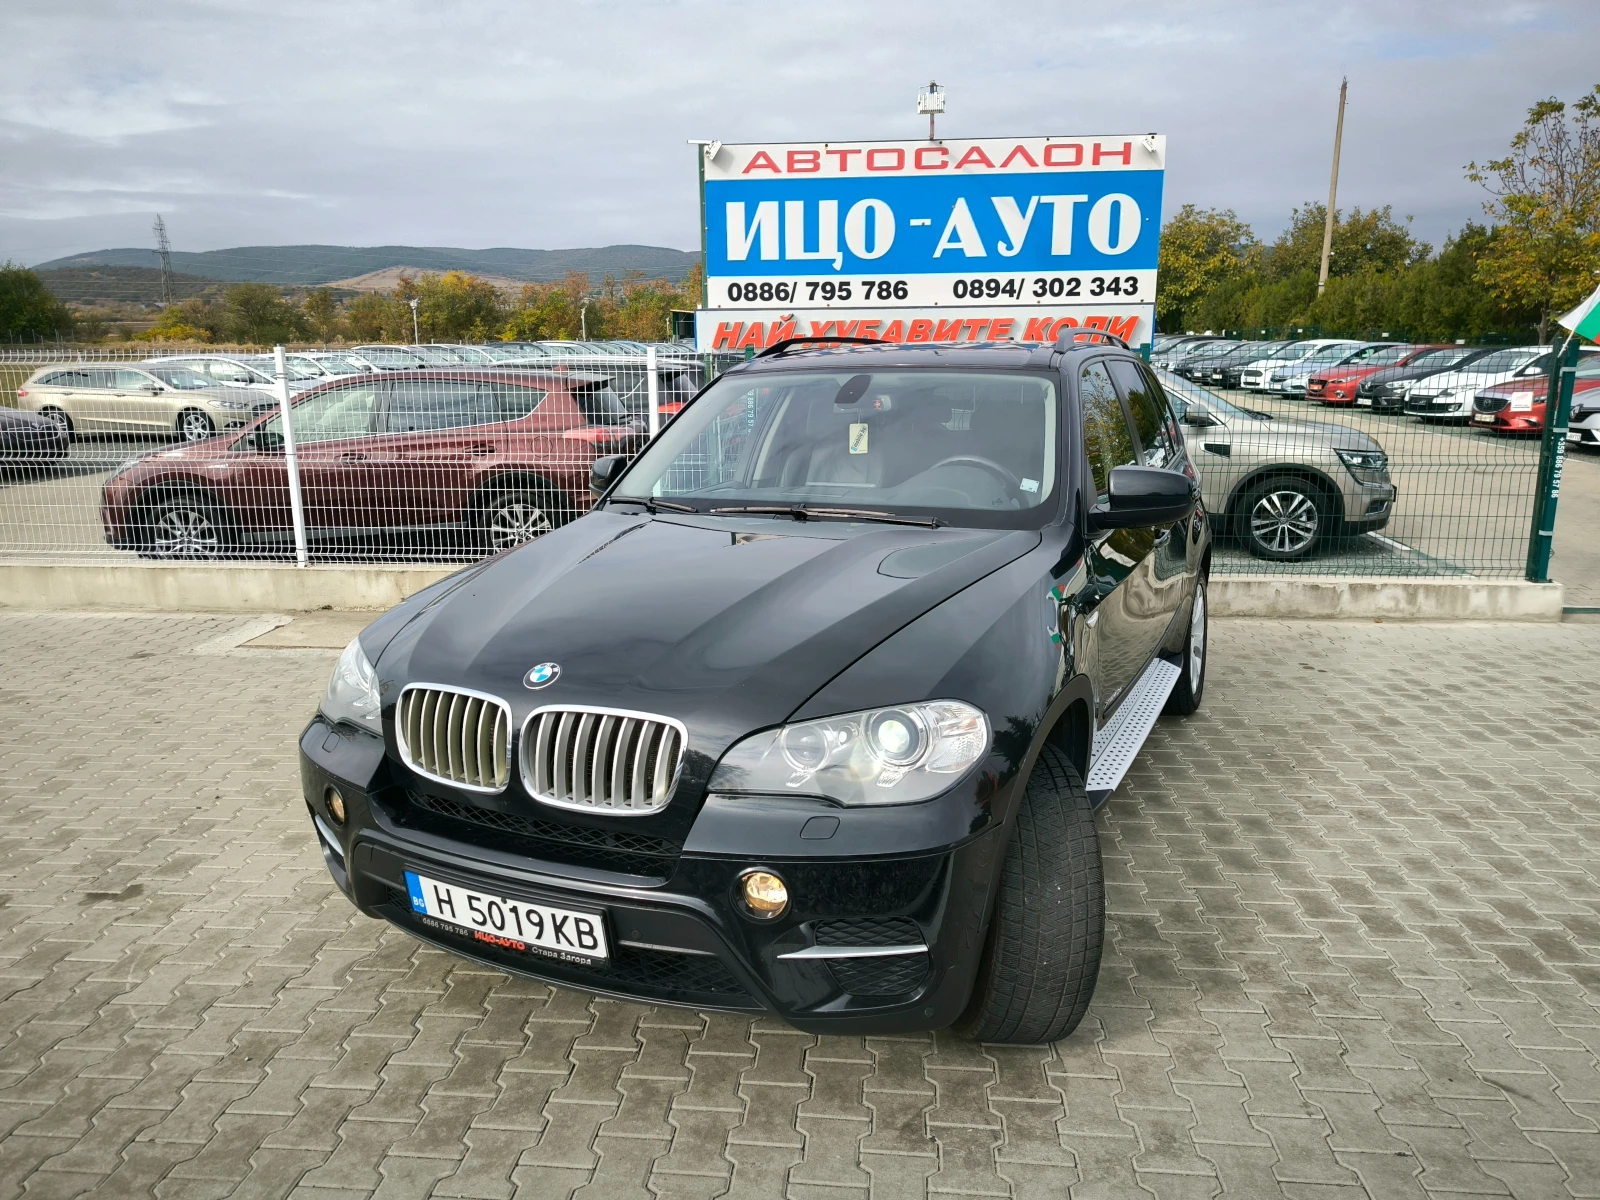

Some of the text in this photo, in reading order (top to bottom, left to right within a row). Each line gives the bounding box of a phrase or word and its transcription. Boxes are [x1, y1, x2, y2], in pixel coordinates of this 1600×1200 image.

[741, 141, 1133, 175] АВТОСАЛОН
[727, 280, 909, 304] 0886/ 795 786
[952, 276, 1139, 300] 0894/ 302 343
[1557, 437, 1565, 453] +359
[1555, 456, 1563, 468] 886
[1554, 470, 1561, 478] 79
[1553, 480, 1560, 488] 57
[412, 895, 425, 908] BG
[531, 946, 558, 958] Стара
[560, 952, 592, 966] Загора
